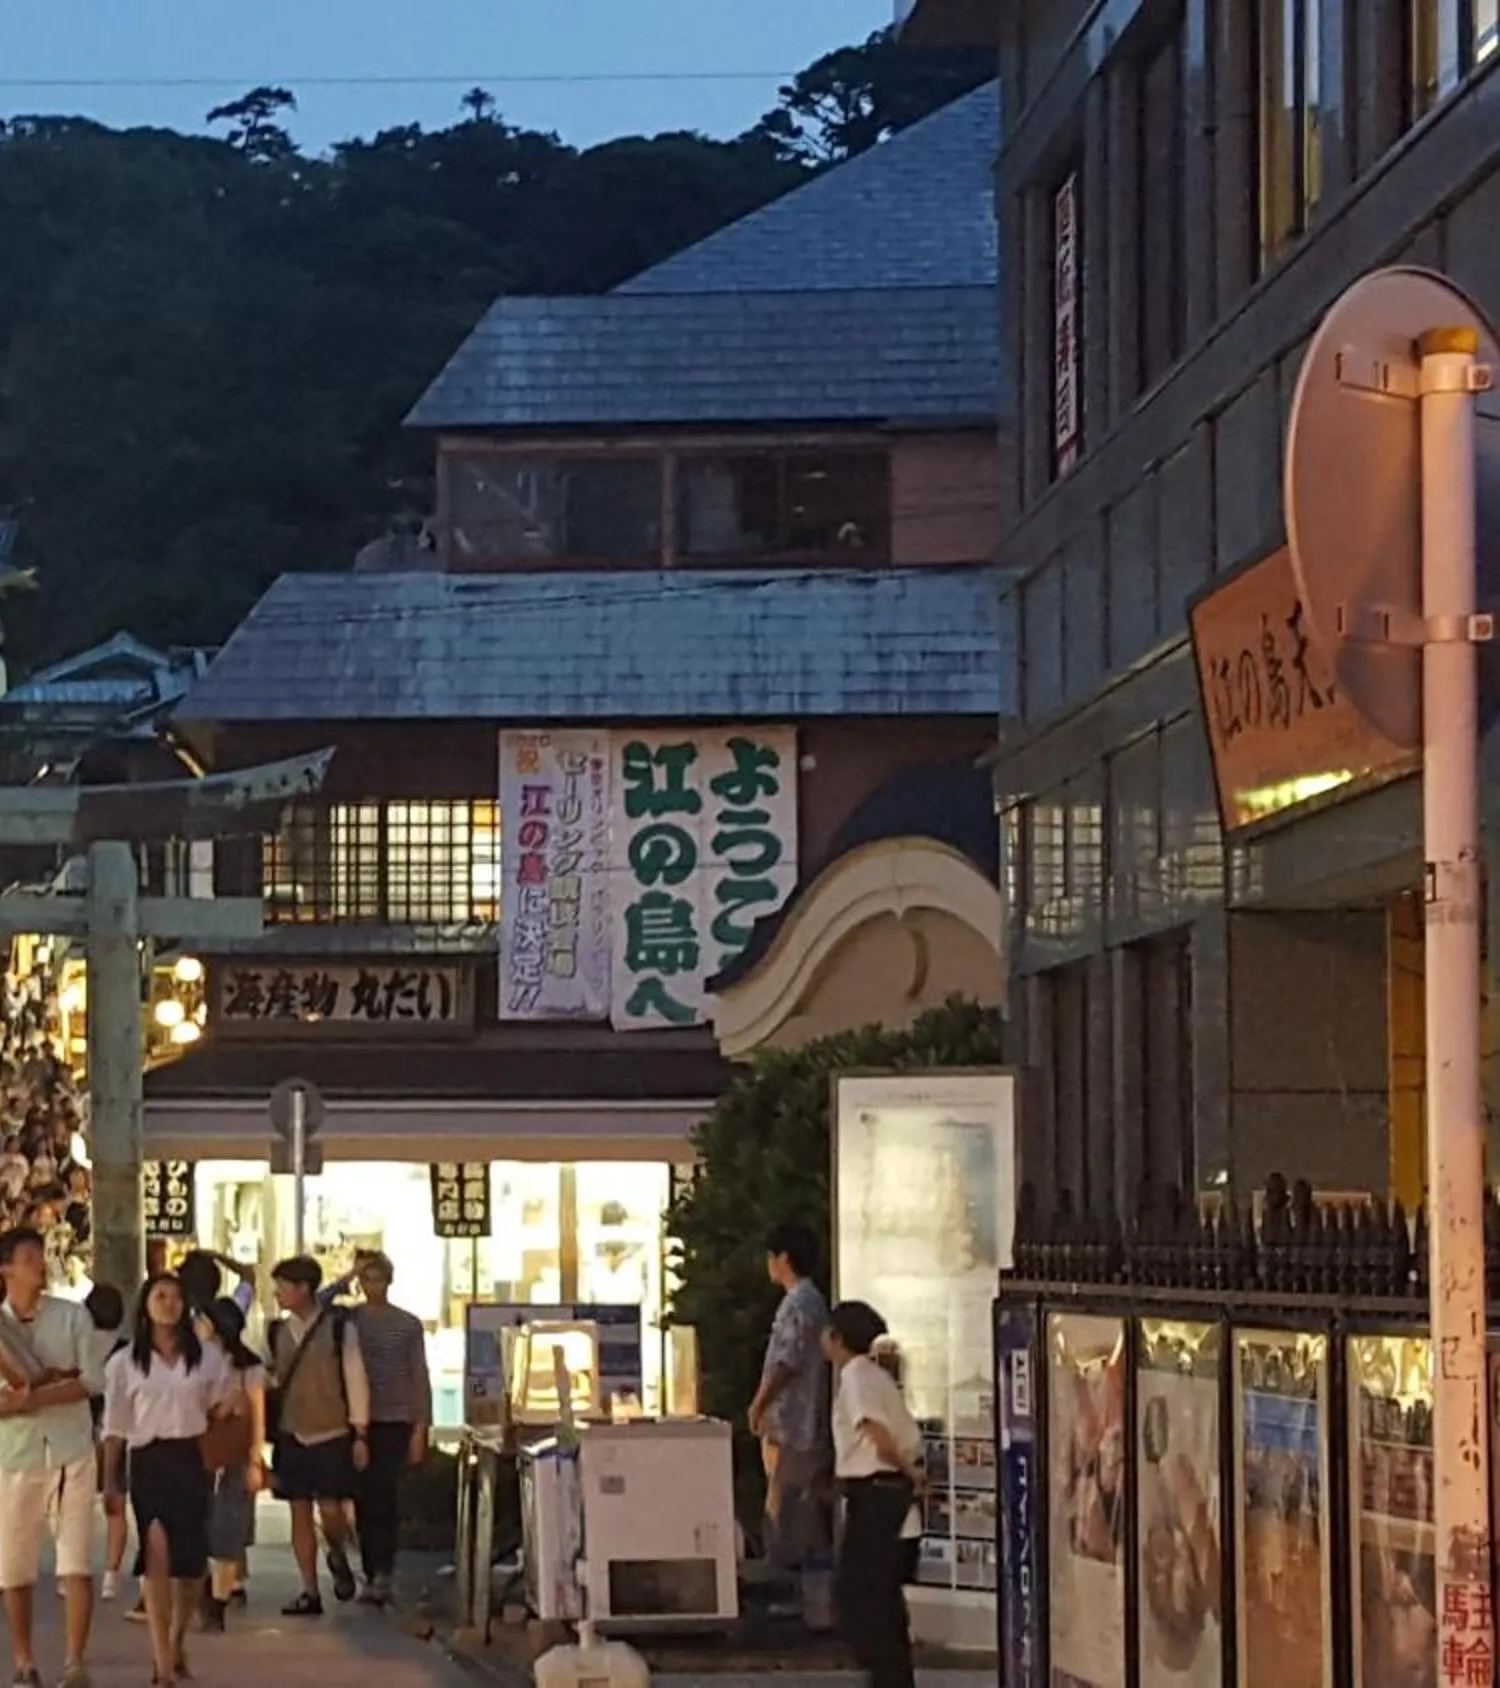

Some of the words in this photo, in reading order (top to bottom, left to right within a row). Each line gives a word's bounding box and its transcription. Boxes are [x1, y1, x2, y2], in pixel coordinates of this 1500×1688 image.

[622, 739, 702, 1022] 江の島へ
[709, 736, 782, 968] ようこ
[225, 968, 339, 1020] 海産物
[350, 967, 452, 1021] 丸だい
